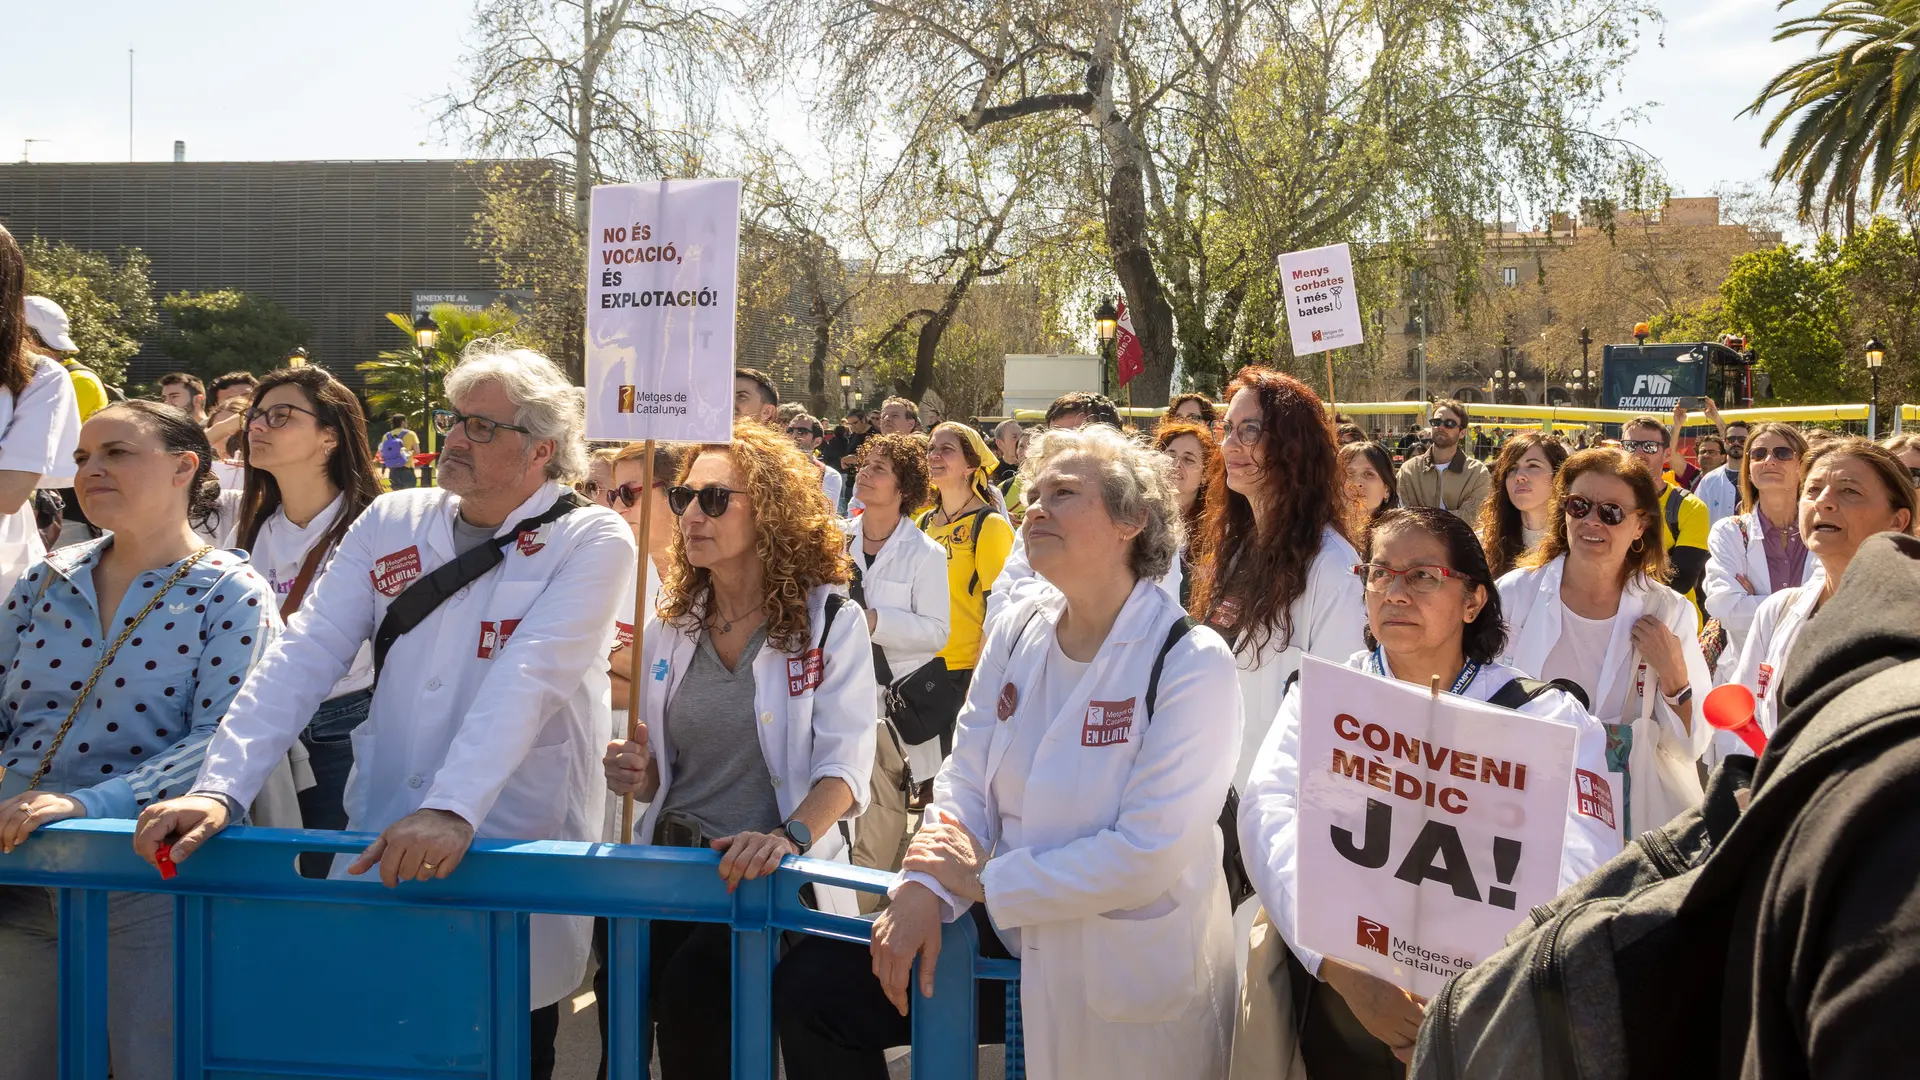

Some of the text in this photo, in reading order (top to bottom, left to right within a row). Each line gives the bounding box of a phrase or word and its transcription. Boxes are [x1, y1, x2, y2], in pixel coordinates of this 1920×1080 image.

[603, 222, 651, 244] NO ÉS
[602, 242, 682, 265] VOCACIÓ,
[602, 268, 622, 287] ÉS
[1292, 266, 1329, 280] Menys
[1294, 276, 1344, 292] corbates
[416, 294, 468, 302] UNEIX-TE AL
[601, 287, 717, 309] EXPLOTACIÓ!
[1296, 292, 1328, 305] i més
[464, 304, 483, 312] QUE
[1298, 302, 1333, 317] bates!
[636, 391, 687, 404] Metges de
[636, 404, 687, 416] Catalunya
[377, 579, 387, 590] EN
[791, 679, 803, 692] EN
[1451, 664, 1476, 695] OLYMPUS
[1085, 730, 1099, 744] EN
[1333, 712, 1527, 791] CONVENI
[1331, 747, 1469, 815] MÈDIC
[1330, 796, 1522, 911] JA!
[1393, 936, 1473, 970] Metges de
[1392, 950, 1457, 977] Catalun
